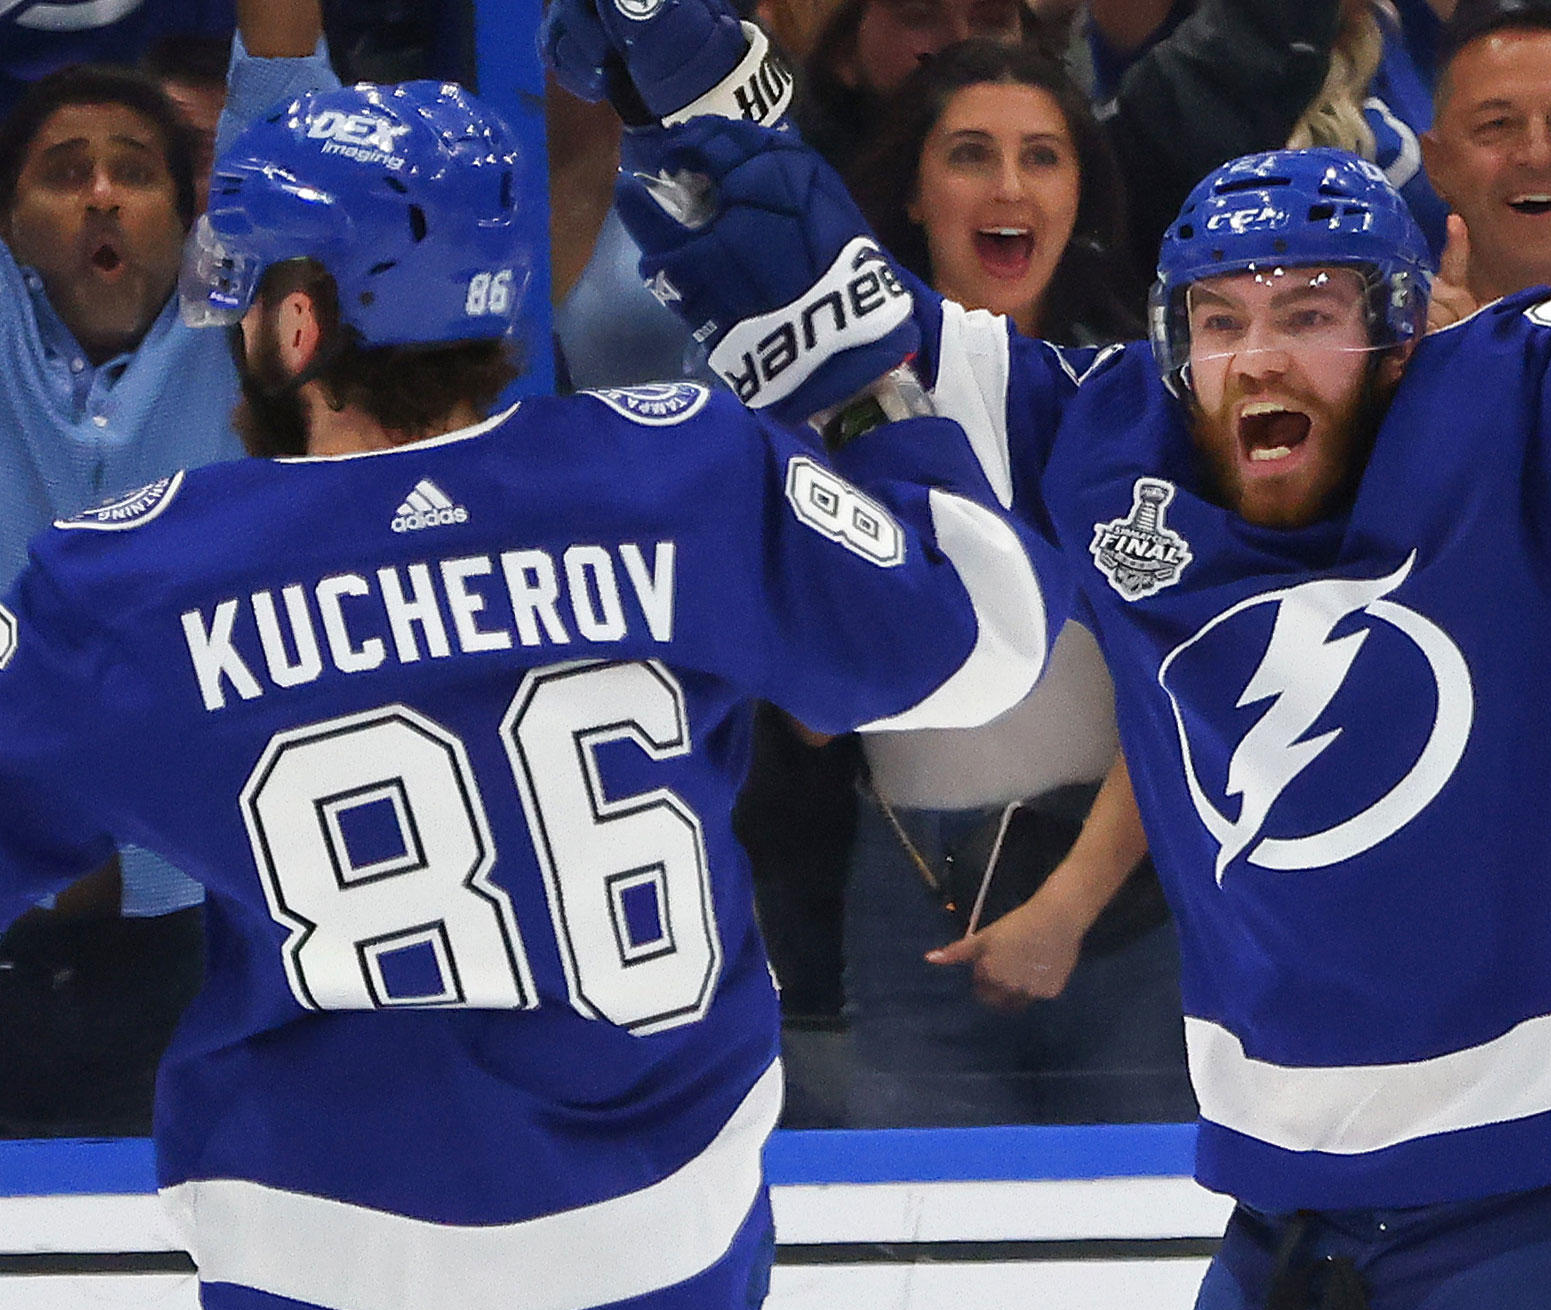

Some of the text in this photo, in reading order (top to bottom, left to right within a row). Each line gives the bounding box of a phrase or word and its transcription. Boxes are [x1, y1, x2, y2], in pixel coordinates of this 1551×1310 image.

[308, 111, 411, 152] DEX
[464, 270, 512, 317] 86
[391, 508, 468, 533] adidas
[785, 456, 905, 568] 8
[1100, 532, 1181, 564] FINAL
[181, 541, 675, 711] KUCHEROV
[238, 655, 724, 1037] 86
